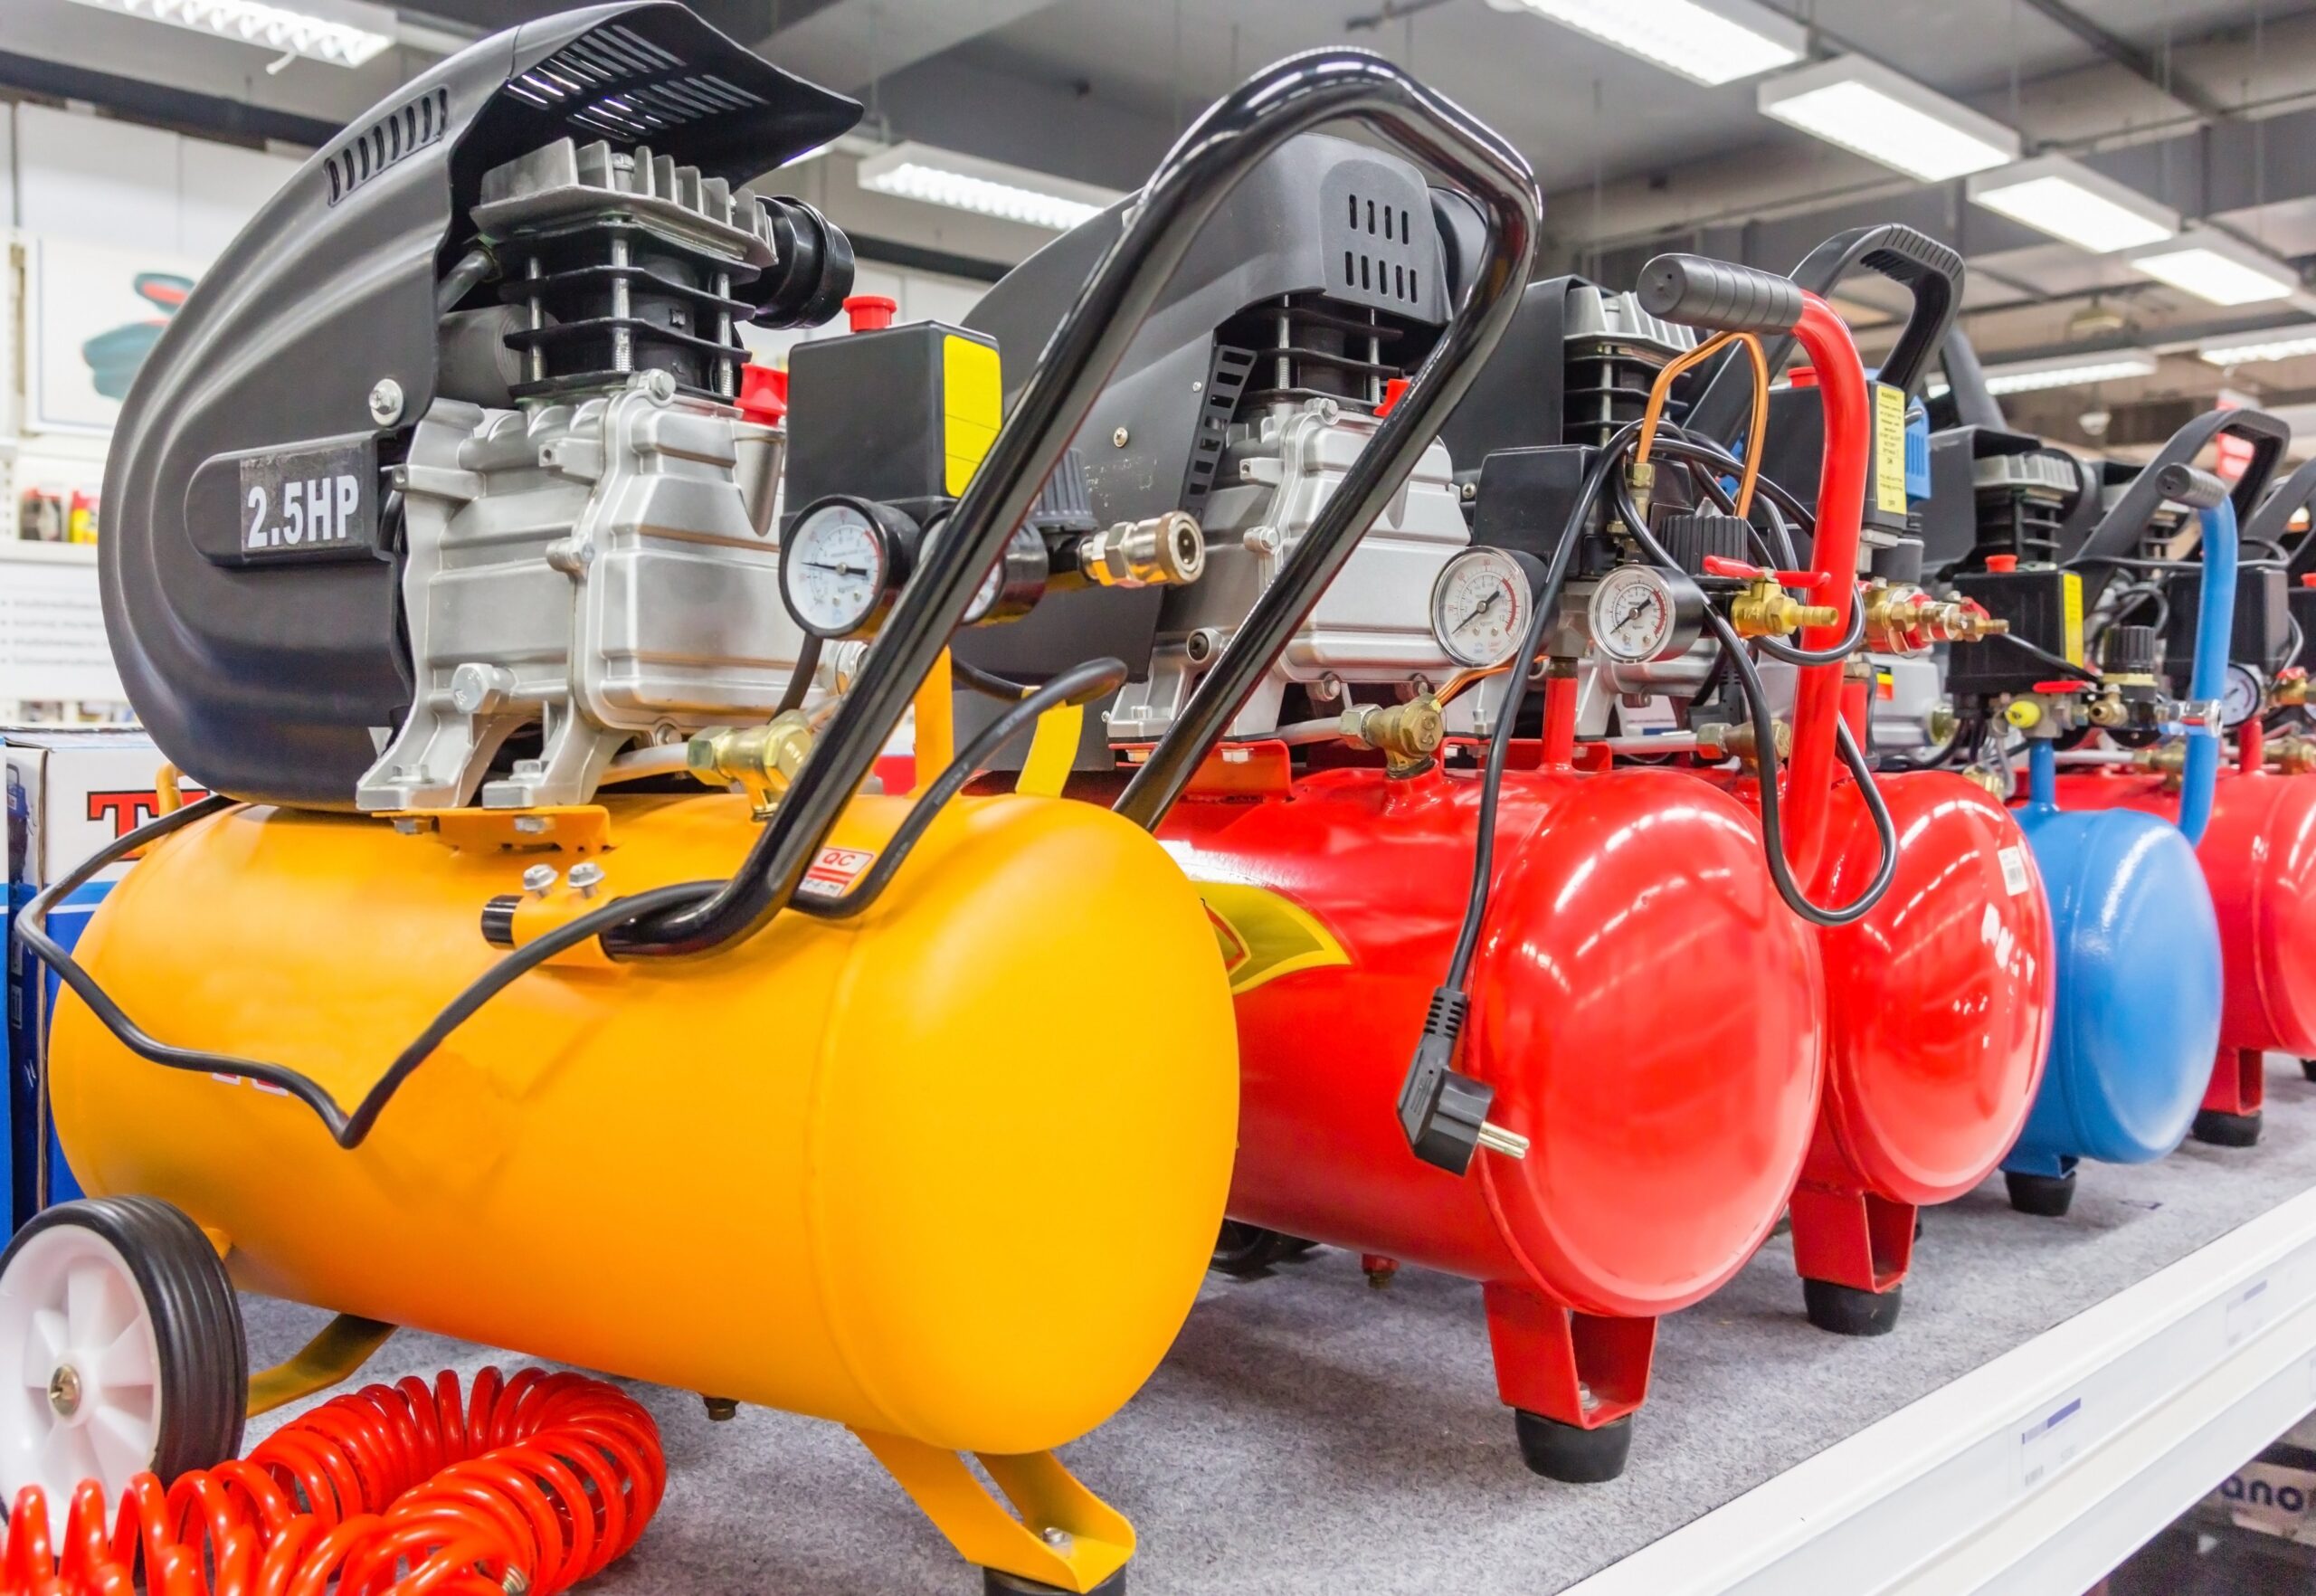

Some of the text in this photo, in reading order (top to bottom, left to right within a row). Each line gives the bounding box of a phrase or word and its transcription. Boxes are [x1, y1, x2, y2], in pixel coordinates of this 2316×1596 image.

[248, 475, 359, 548] 2.5HP
[822, 851, 856, 867] QC
[2222, 1475, 2316, 1513] ano
